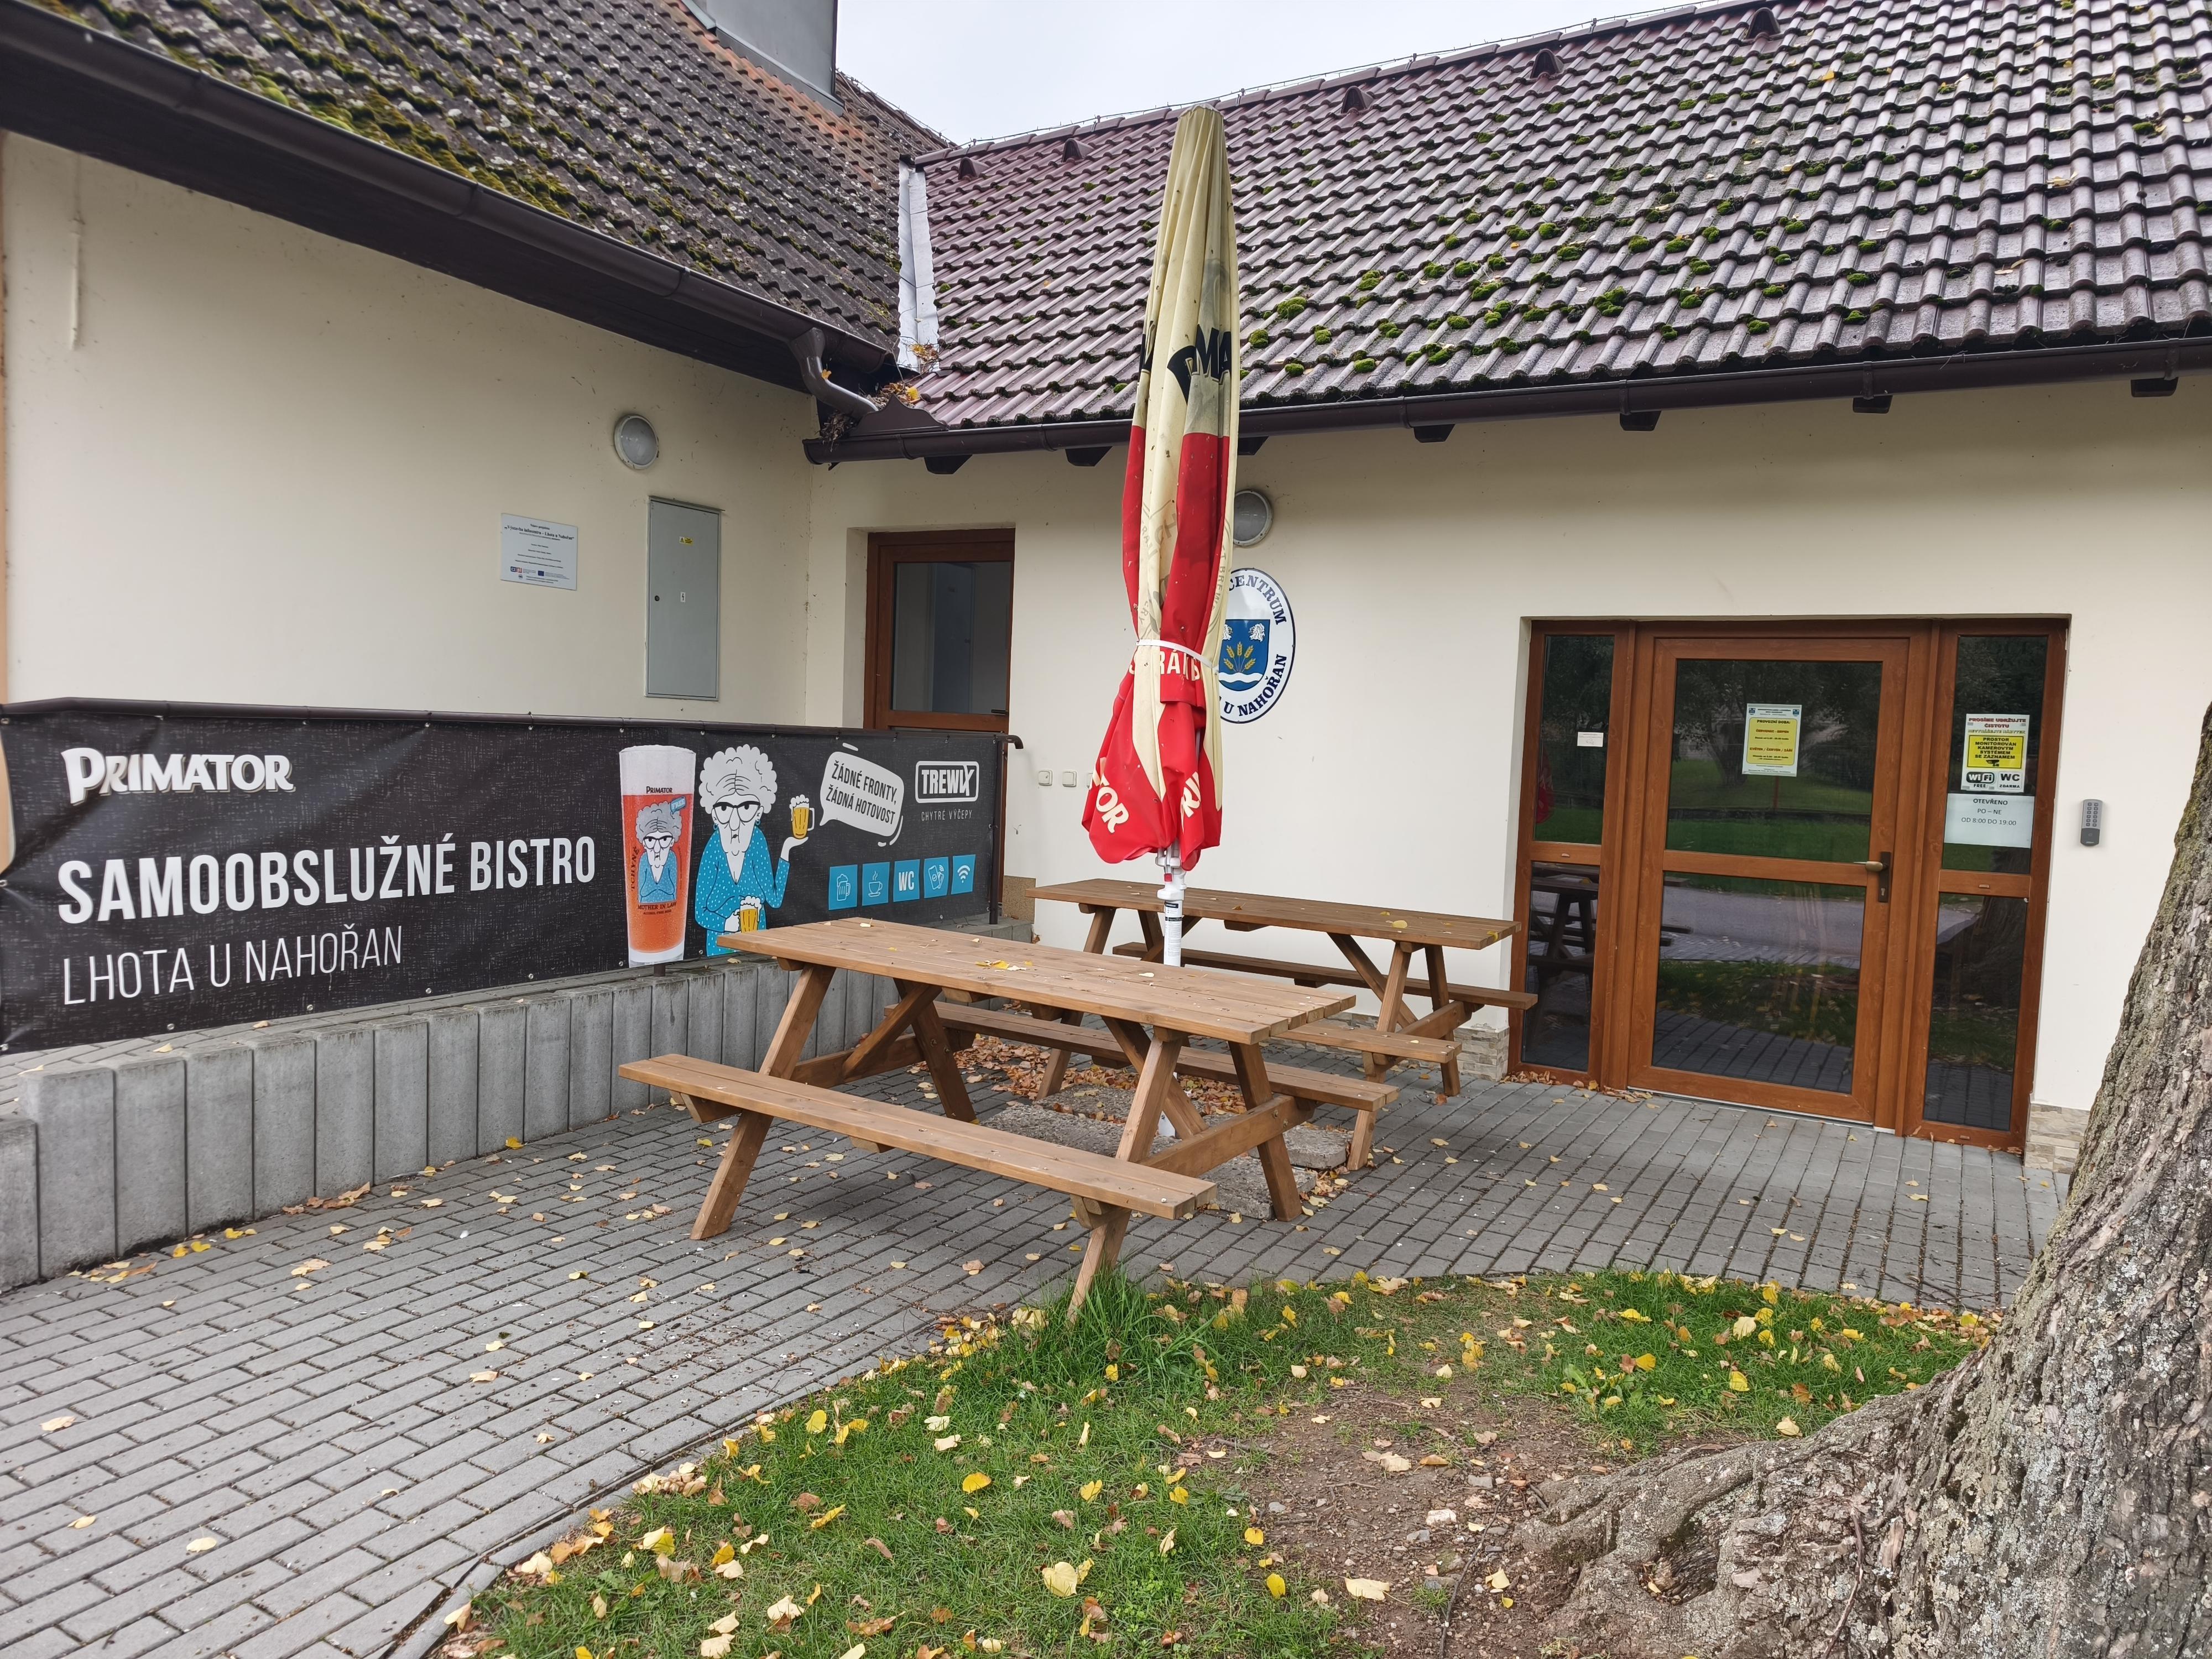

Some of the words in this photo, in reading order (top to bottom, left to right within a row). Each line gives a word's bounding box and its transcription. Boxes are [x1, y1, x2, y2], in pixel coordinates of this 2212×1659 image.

[1223, 701, 1235, 714] U
[1238, 654, 1287, 716] NAHOŘAN
[831, 760, 863, 789] ŽÁDNÉ
[863, 775, 898, 805] FRONTY,
[921, 765, 975, 796] TREWIX
[2000, 773, 2020, 781] WC
[826, 784, 855, 810] ŽÁDNÁ
[855, 794, 896, 825] HOTOVOST
[921, 808, 946, 822] CHYTRÉ
[948, 808, 973, 820] VÝČEPY
[58, 833, 456, 924] SAMOOBSLUŽNÉ
[470, 836, 595, 891] BISTRO
[898, 870, 915, 891] WC
[64, 947, 195, 1005] LHOTA
[210, 943, 231, 987] U
[246, 923, 402, 983] NAHOŘAN
